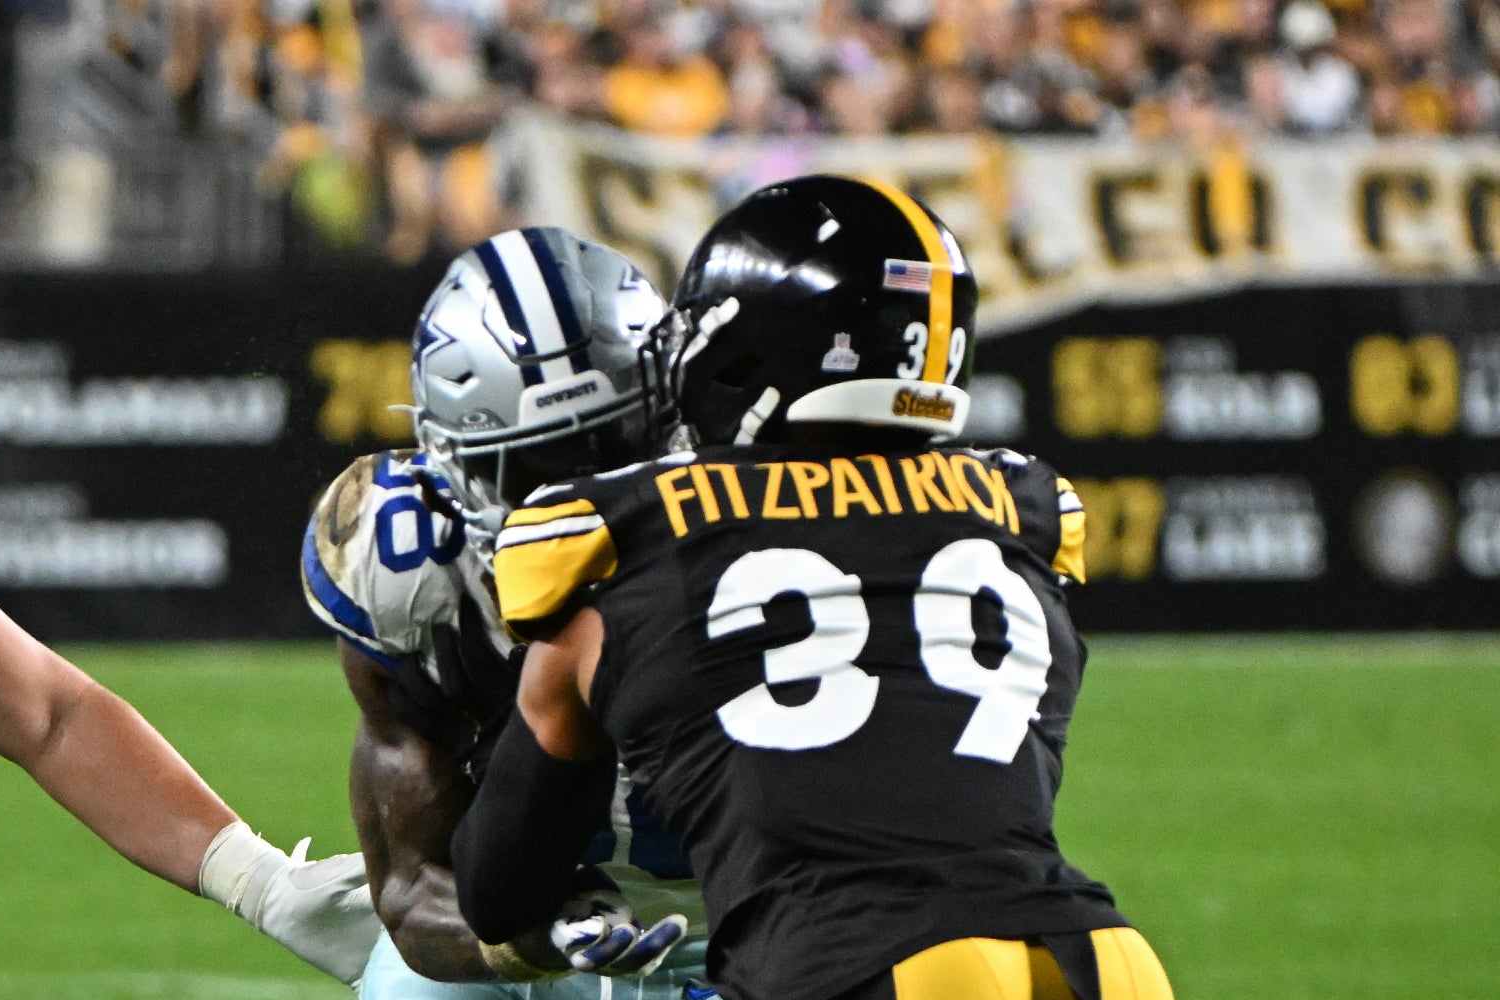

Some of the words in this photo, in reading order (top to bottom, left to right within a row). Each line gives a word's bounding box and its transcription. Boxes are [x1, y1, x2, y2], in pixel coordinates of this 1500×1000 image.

[897, 321, 967, 386] 39
[655, 451, 1020, 538] FITZPATRICK
[707, 538, 1052, 764] 39
